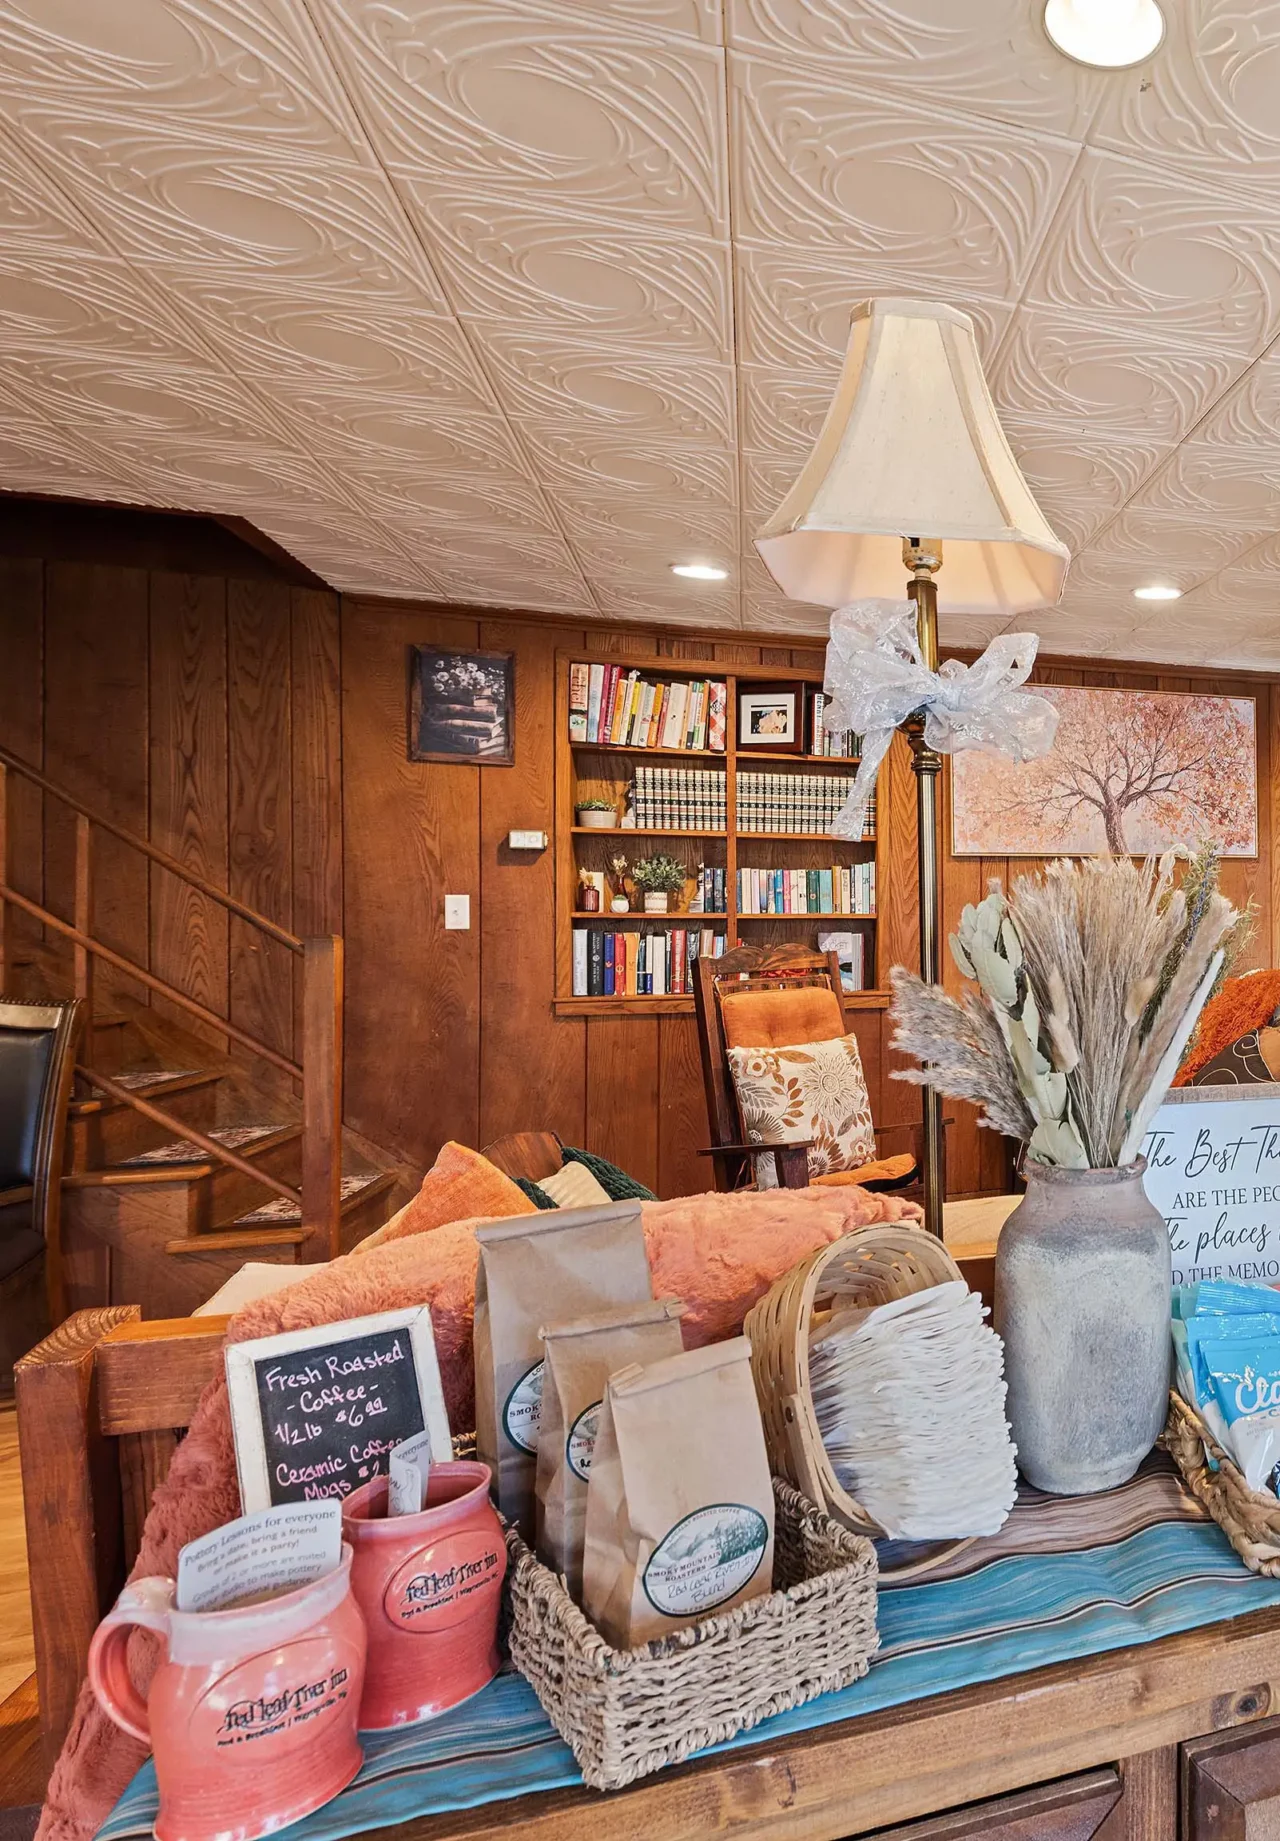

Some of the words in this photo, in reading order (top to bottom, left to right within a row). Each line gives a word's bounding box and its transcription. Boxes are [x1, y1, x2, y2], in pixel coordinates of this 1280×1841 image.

[1145, 1130, 1177, 1168] The
[1184, 1128, 1258, 1178] Best
[1172, 1190, 1207, 1210] ARE
[1211, 1187, 1248, 1207] THE
[1194, 1211, 1272, 1264] places
[1188, 1267, 1222, 1284] THE
[265, 1367, 322, 1391] Fresh
[325, 1340, 405, 1379] Roasted
[275, 1423, 306, 1445] 1/2
[306, 1423, 322, 1439] lb
[276, 1455, 347, 1487] Ceramic
[304, 1478, 352, 1501] Mugs
[185, 1541, 218, 1567] Pottery
[221, 1521, 262, 1547] Lessons
[265, 1515, 281, 1529] for
[285, 1510, 337, 1526] everyone
[252, 1531, 278, 1545] bring
[289, 1525, 318, 1535] friend
[224, 1554, 249, 1570] make
[270, 1539, 300, 1554] party!
[252, 1559, 279, 1571] more
[297, 1551, 327, 1562] invited
[648, 1567, 679, 1578] SMOKY
[680, 1551, 722, 1571] MOUNTAIN
[260, 1569, 286, 1583] make
[288, 1564, 322, 1578] pottery
[665, 1565, 706, 1583] ROASTERS
